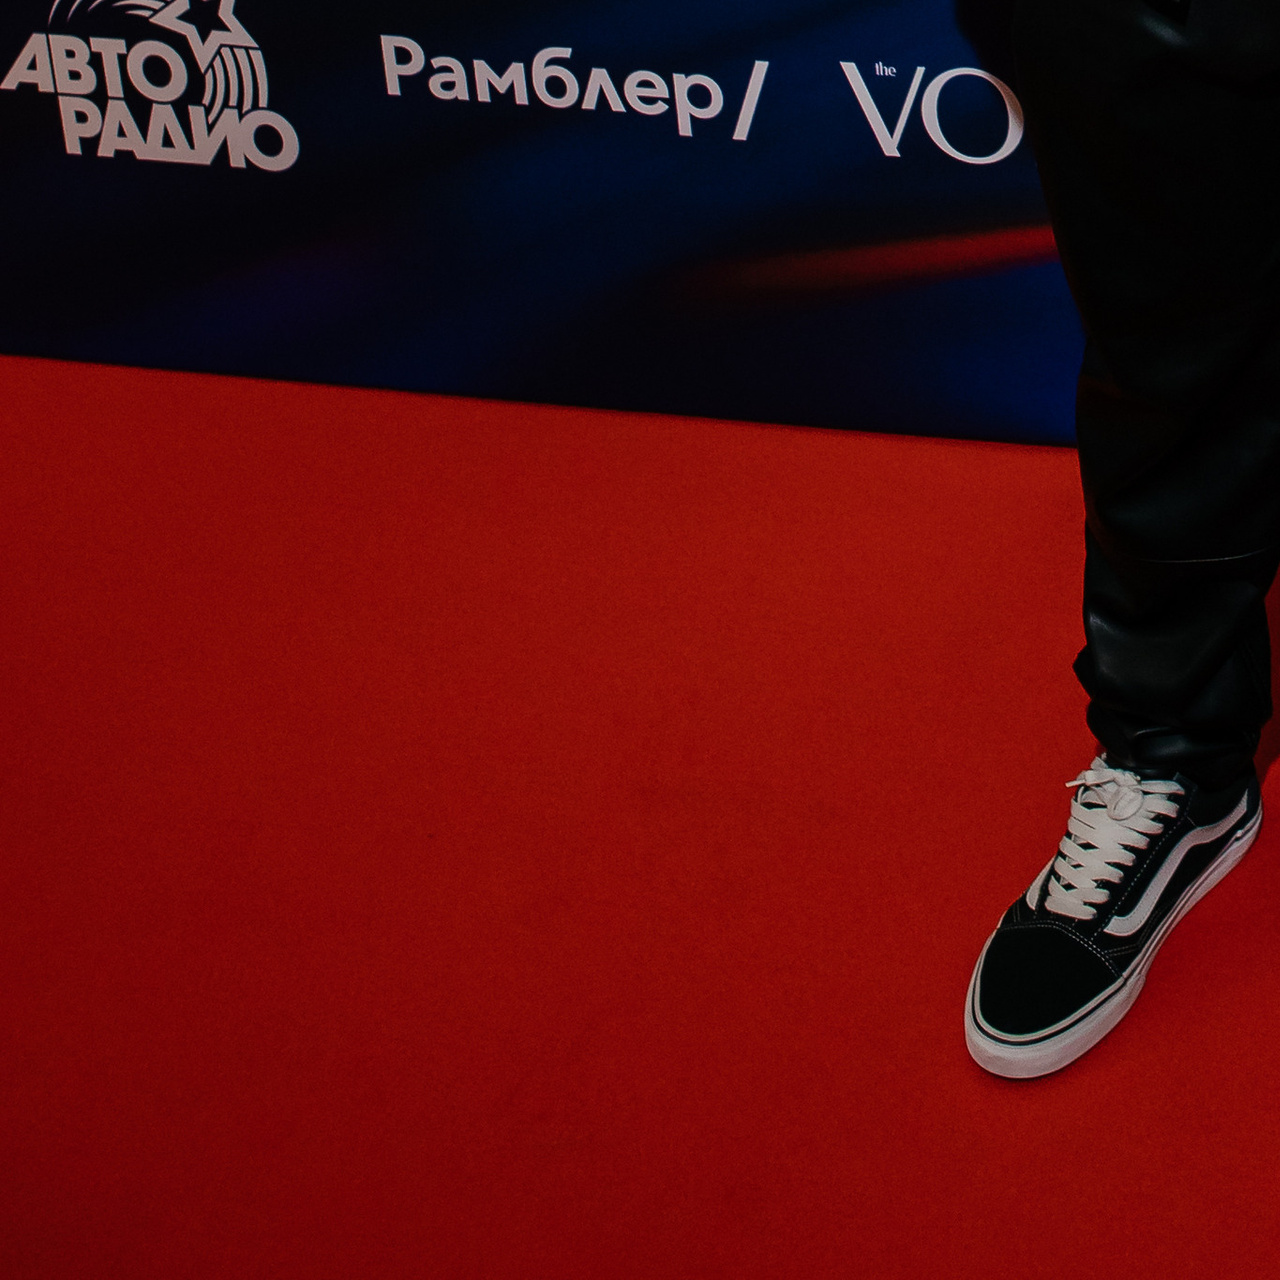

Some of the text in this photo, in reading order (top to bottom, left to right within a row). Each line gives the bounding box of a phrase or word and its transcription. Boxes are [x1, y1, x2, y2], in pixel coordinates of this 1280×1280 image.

[0, 32, 189, 103] АВТО
[874, 61, 897, 77] the
[57, 94, 300, 172] РАДИО
